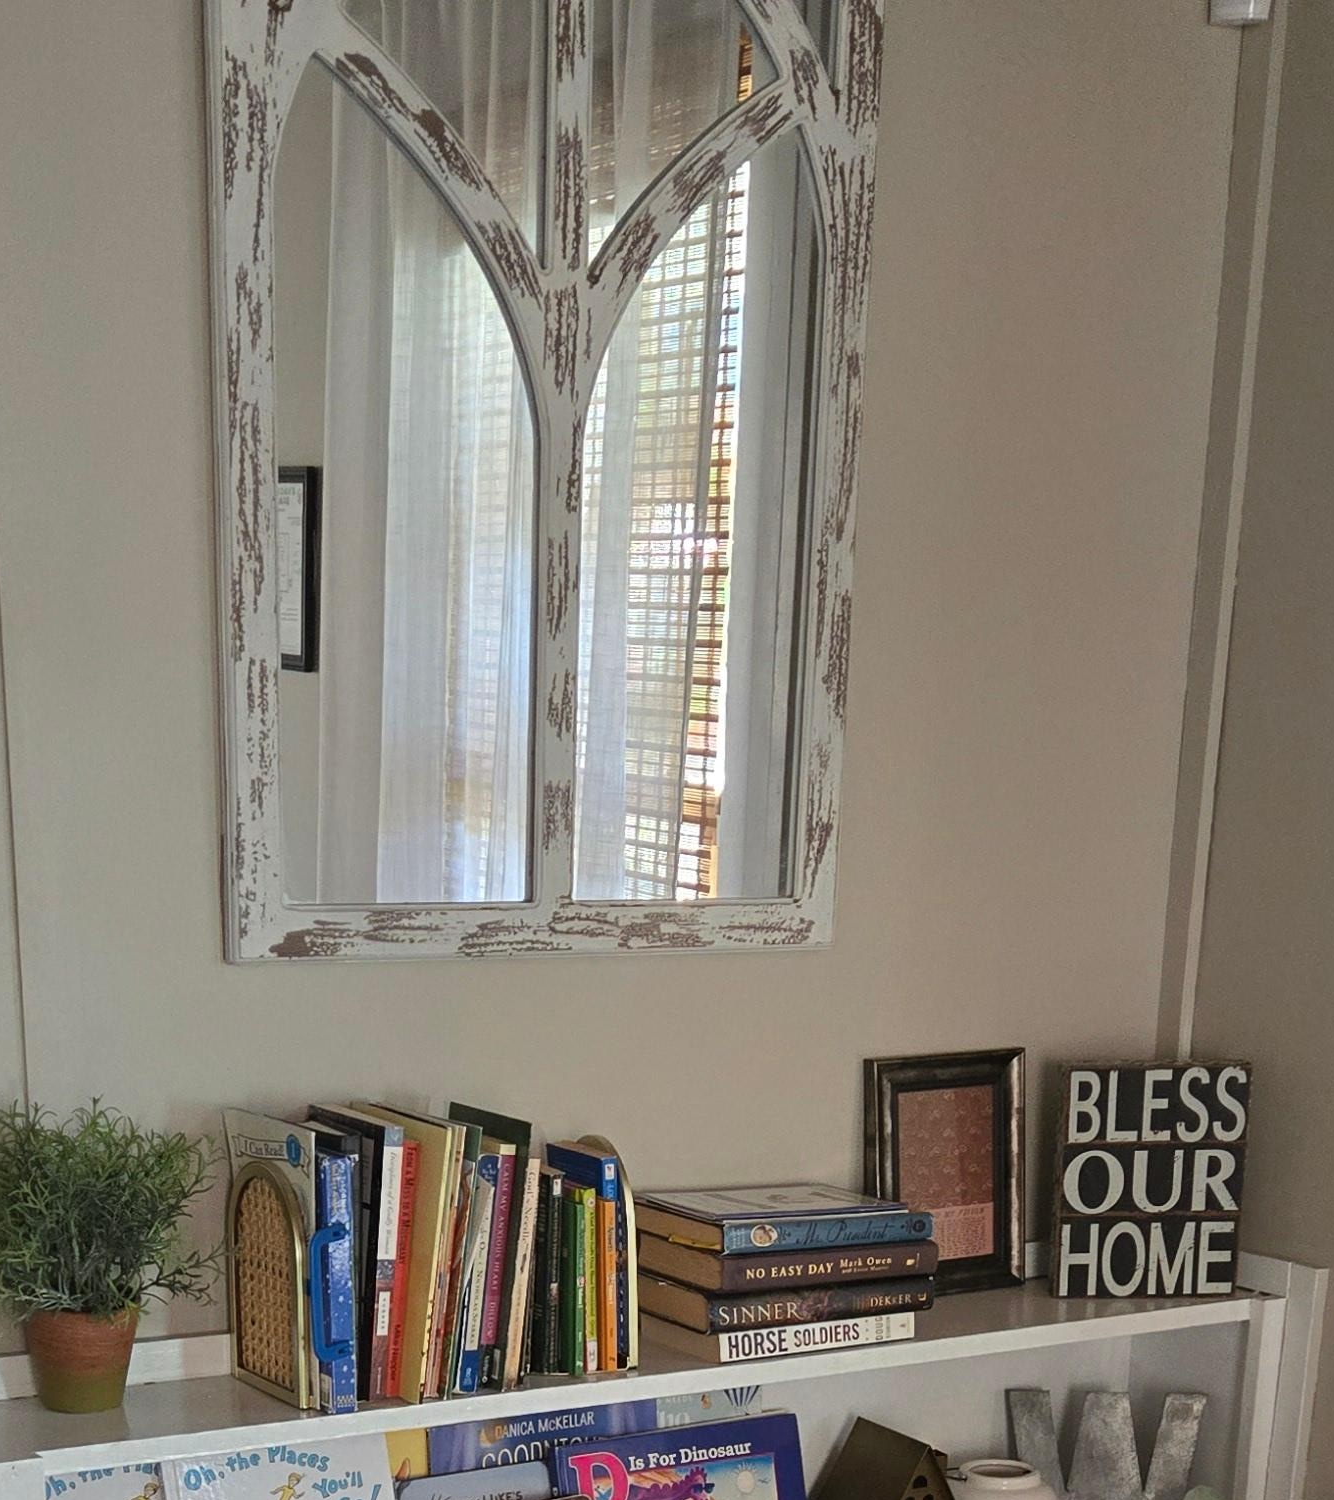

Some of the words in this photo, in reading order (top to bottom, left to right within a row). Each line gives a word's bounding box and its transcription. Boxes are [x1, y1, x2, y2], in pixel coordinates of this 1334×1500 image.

[1067, 1066, 1248, 1144] BLESS
[502, 1162, 510, 1191] CALM
[526, 1171, 536, 1204] God's
[1063, 1148, 1239, 1215] OUR
[494, 1215, 507, 1258] ANXIOUS
[522, 1206, 534, 1244] Needle
[746, 1268, 765, 1280] NO
[771, 1265, 803, 1278] EASY
[808, 1262, 835, 1276] DAY
[839, 1258, 863, 1269] Mark
[867, 1256, 892, 1267] Owen
[1059, 1220, 1235, 1298] HOME
[719, 1300, 805, 1326] SINNER
[870, 1294, 912, 1307] DEKKER
[728, 1329, 788, 1359] HORSE
[794, 1323, 860, 1348] SOLDIERS
[495, 1420, 535, 1440] DANICA
[538, 1411, 595, 1433] McKELLAR
[184, 1468, 226, 1491] Oh,
[225, 1452, 261, 1472] the
[267, 1446, 330, 1472] Places
[629, 1455, 644, 1472] Is
[649, 1450, 675, 1468] For
[679, 1440, 752, 1464] Dinosaur
[312, 1470, 363, 1498] You'll
